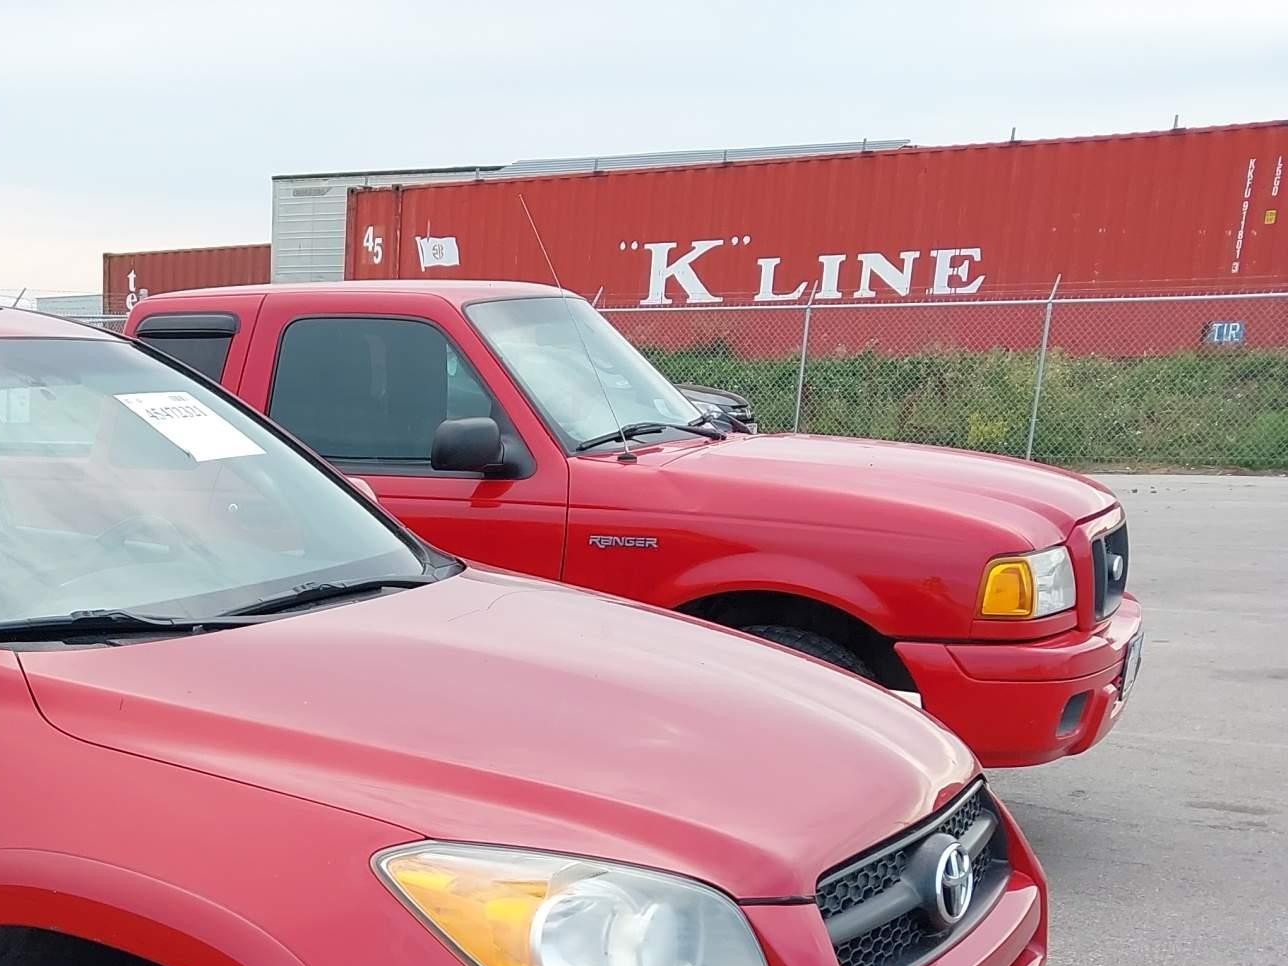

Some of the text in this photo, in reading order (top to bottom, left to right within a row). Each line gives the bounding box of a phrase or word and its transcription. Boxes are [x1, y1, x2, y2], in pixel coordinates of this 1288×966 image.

[1244, 158, 1256, 198] KKFU
[362, 225, 383, 265] 45
[1236, 200, 1248, 259] 911801
[754, 247, 986, 301] LINE
[1212, 322, 1241, 342] TIR
[588, 535, 659, 549] RANGER
